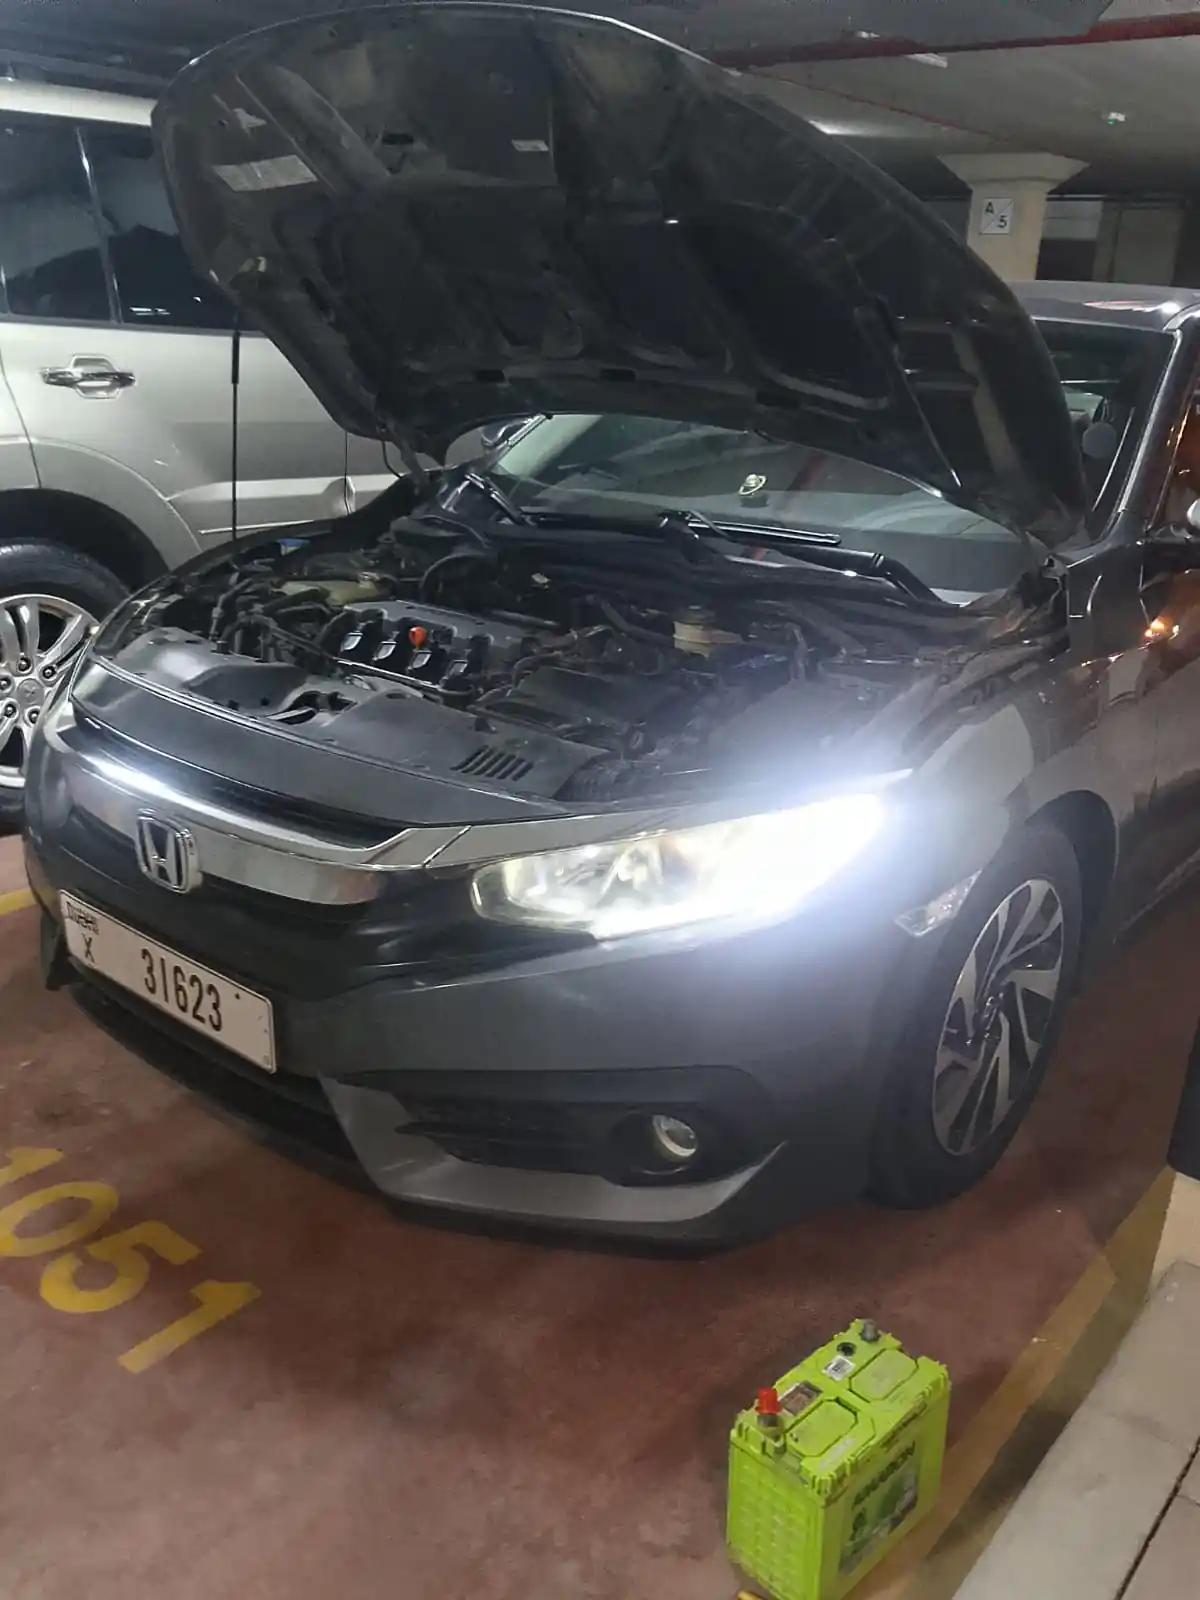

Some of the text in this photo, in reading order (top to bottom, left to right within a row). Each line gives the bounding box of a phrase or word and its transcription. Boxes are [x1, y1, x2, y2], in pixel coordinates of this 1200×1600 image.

[984, 201, 995, 215] A
[997, 215, 1008, 229] 5
[81, 932, 222, 1032] X 31623
